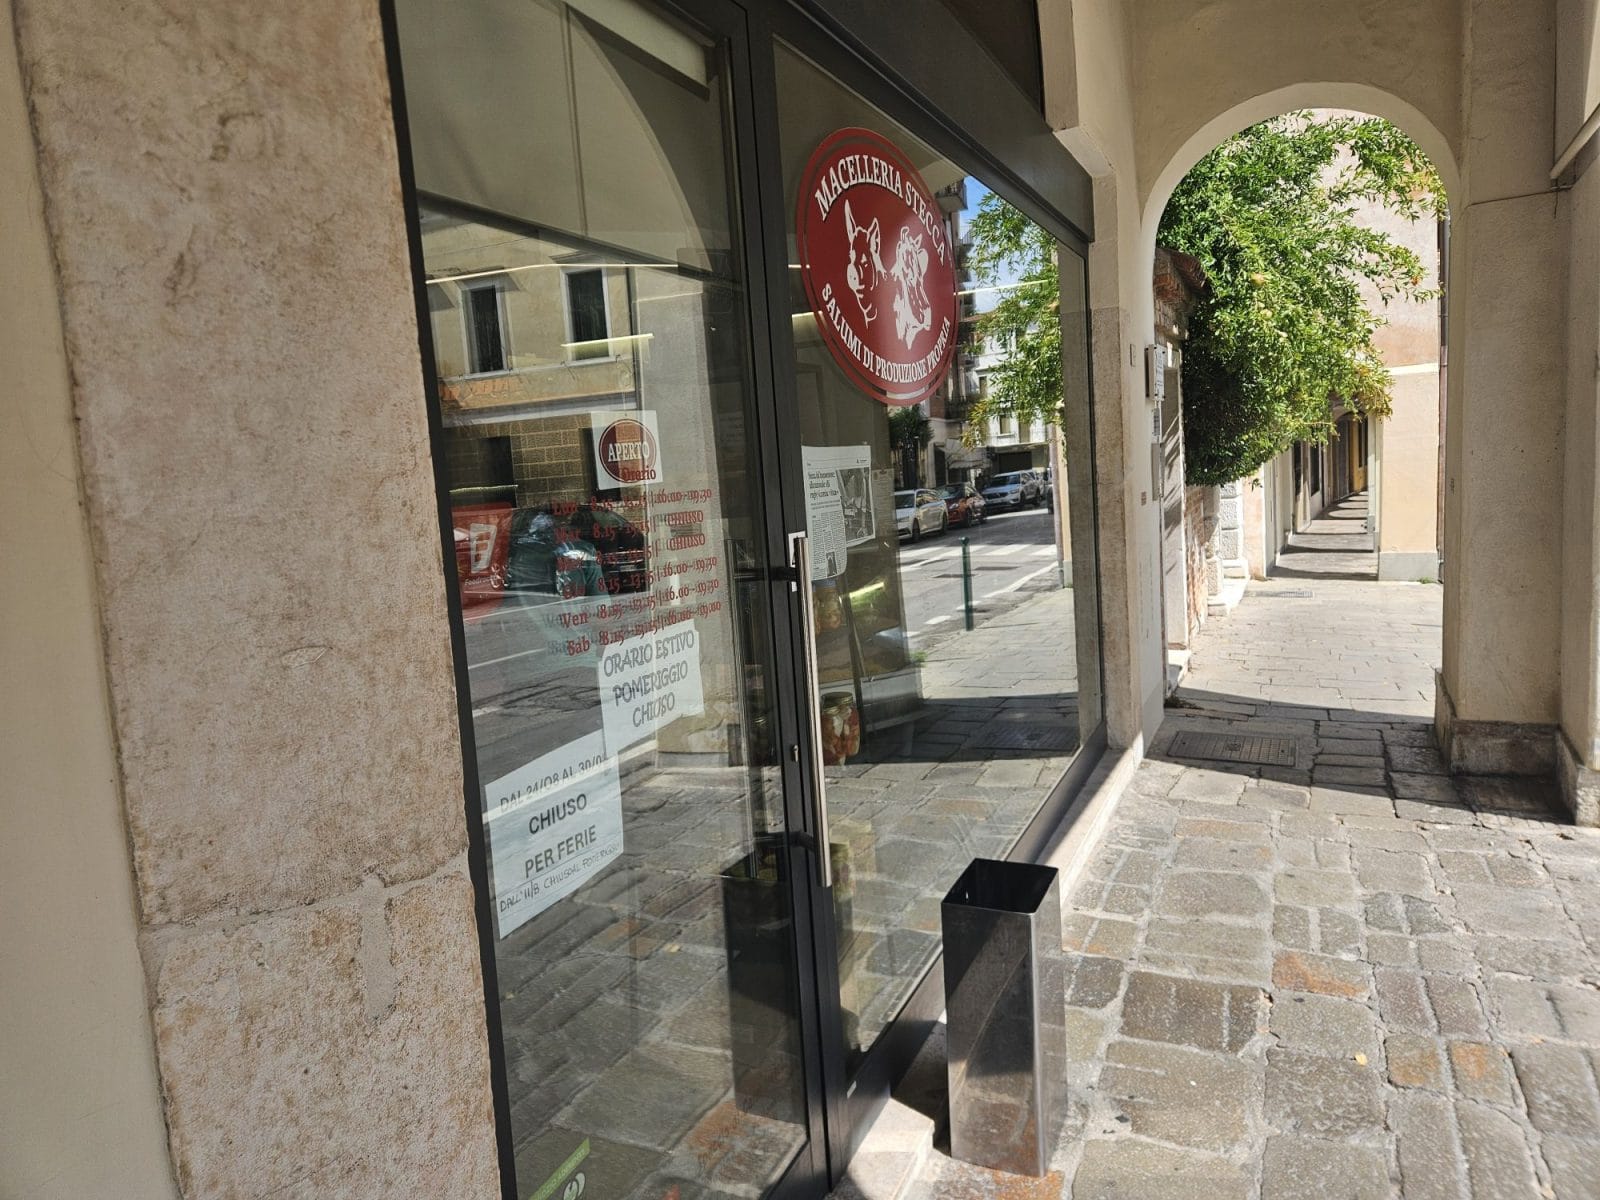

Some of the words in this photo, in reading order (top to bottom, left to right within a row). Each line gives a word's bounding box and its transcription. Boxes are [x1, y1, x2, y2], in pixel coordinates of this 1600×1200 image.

[814, 154, 904, 222] MACELLERIA
[905, 180, 945, 266] STECCA
[822, 282, 861, 361] SALUMI
[863, 347, 875, 372] DI
[875, 355, 928, 383] PRODUZIONE
[927, 317, 951, 373] PROPRIA
[608, 441, 650, 462] APERTO
[622, 466, 656, 481] Orario
[668, 533, 706, 550] CHIUSO
[663, 561, 688, 577] 16.00
[560, 613, 588, 628] Ven
[666, 586, 690, 600] 16.00
[567, 634, 590, 656] Sab
[604, 643, 653, 677] ORARIO
[655, 630, 695, 659] ESTIVO
[613, 660, 688, 707] POMERIGGIO
[500, 791, 522, 810] DAL
[529, 794, 587, 834] CHIUSO
[525, 848, 554, 878] PER
[557, 825, 597, 860] FERIE
